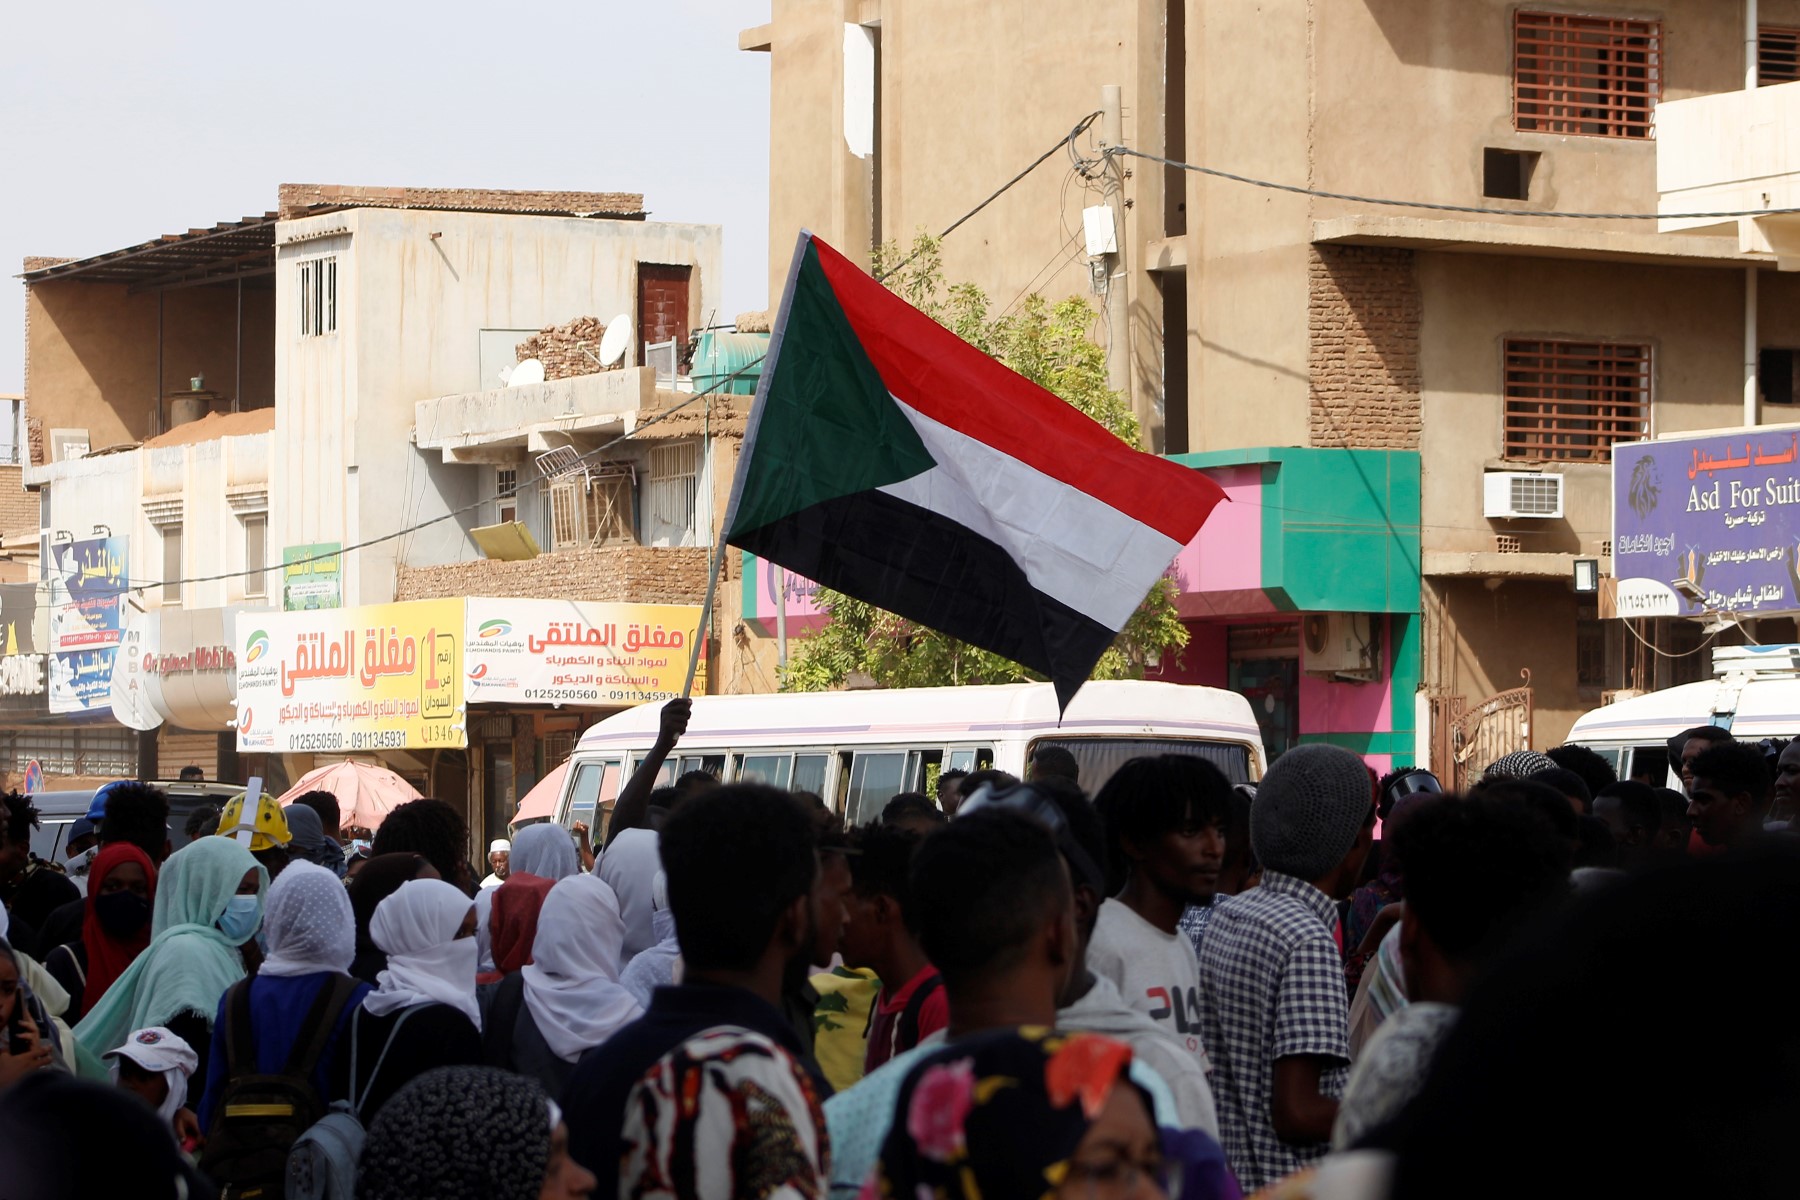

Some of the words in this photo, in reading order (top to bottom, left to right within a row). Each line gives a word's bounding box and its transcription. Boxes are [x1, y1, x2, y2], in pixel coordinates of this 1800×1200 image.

[1686, 481, 1720, 512] Asd
[1729, 480, 1761, 509] For
[528, 622, 616, 654] الملتقى
[622, 624, 684, 653] مغلق
[143, 652, 193, 676] Original
[195, 645, 235, 670] Mobile
[281, 630, 355, 697] الملتقى
[360, 627, 416, 687] مغلق
[545, 655, 594, 667] الكهرباء
[607, 655, 635, 668] البناء
[637, 656, 667, 667] لمواد
[552, 674, 593, 686] الديكور
[605, 674, 649, 686] السباكة
[425, 694, 451, 711] السودان
[524, 688, 598, 700] 0125250560
[609, 690, 680, 701] 0911345931
[279, 703, 303, 724] الديكور
[343, 700, 373, 721] الكهرباء
[380, 698, 399, 719] البناء
[400, 698, 419, 719] لمواد
[289, 732, 342, 750] 0125250560
[351, 730, 406, 749] 0911345931
[429, 724, 453, 742] 1346
